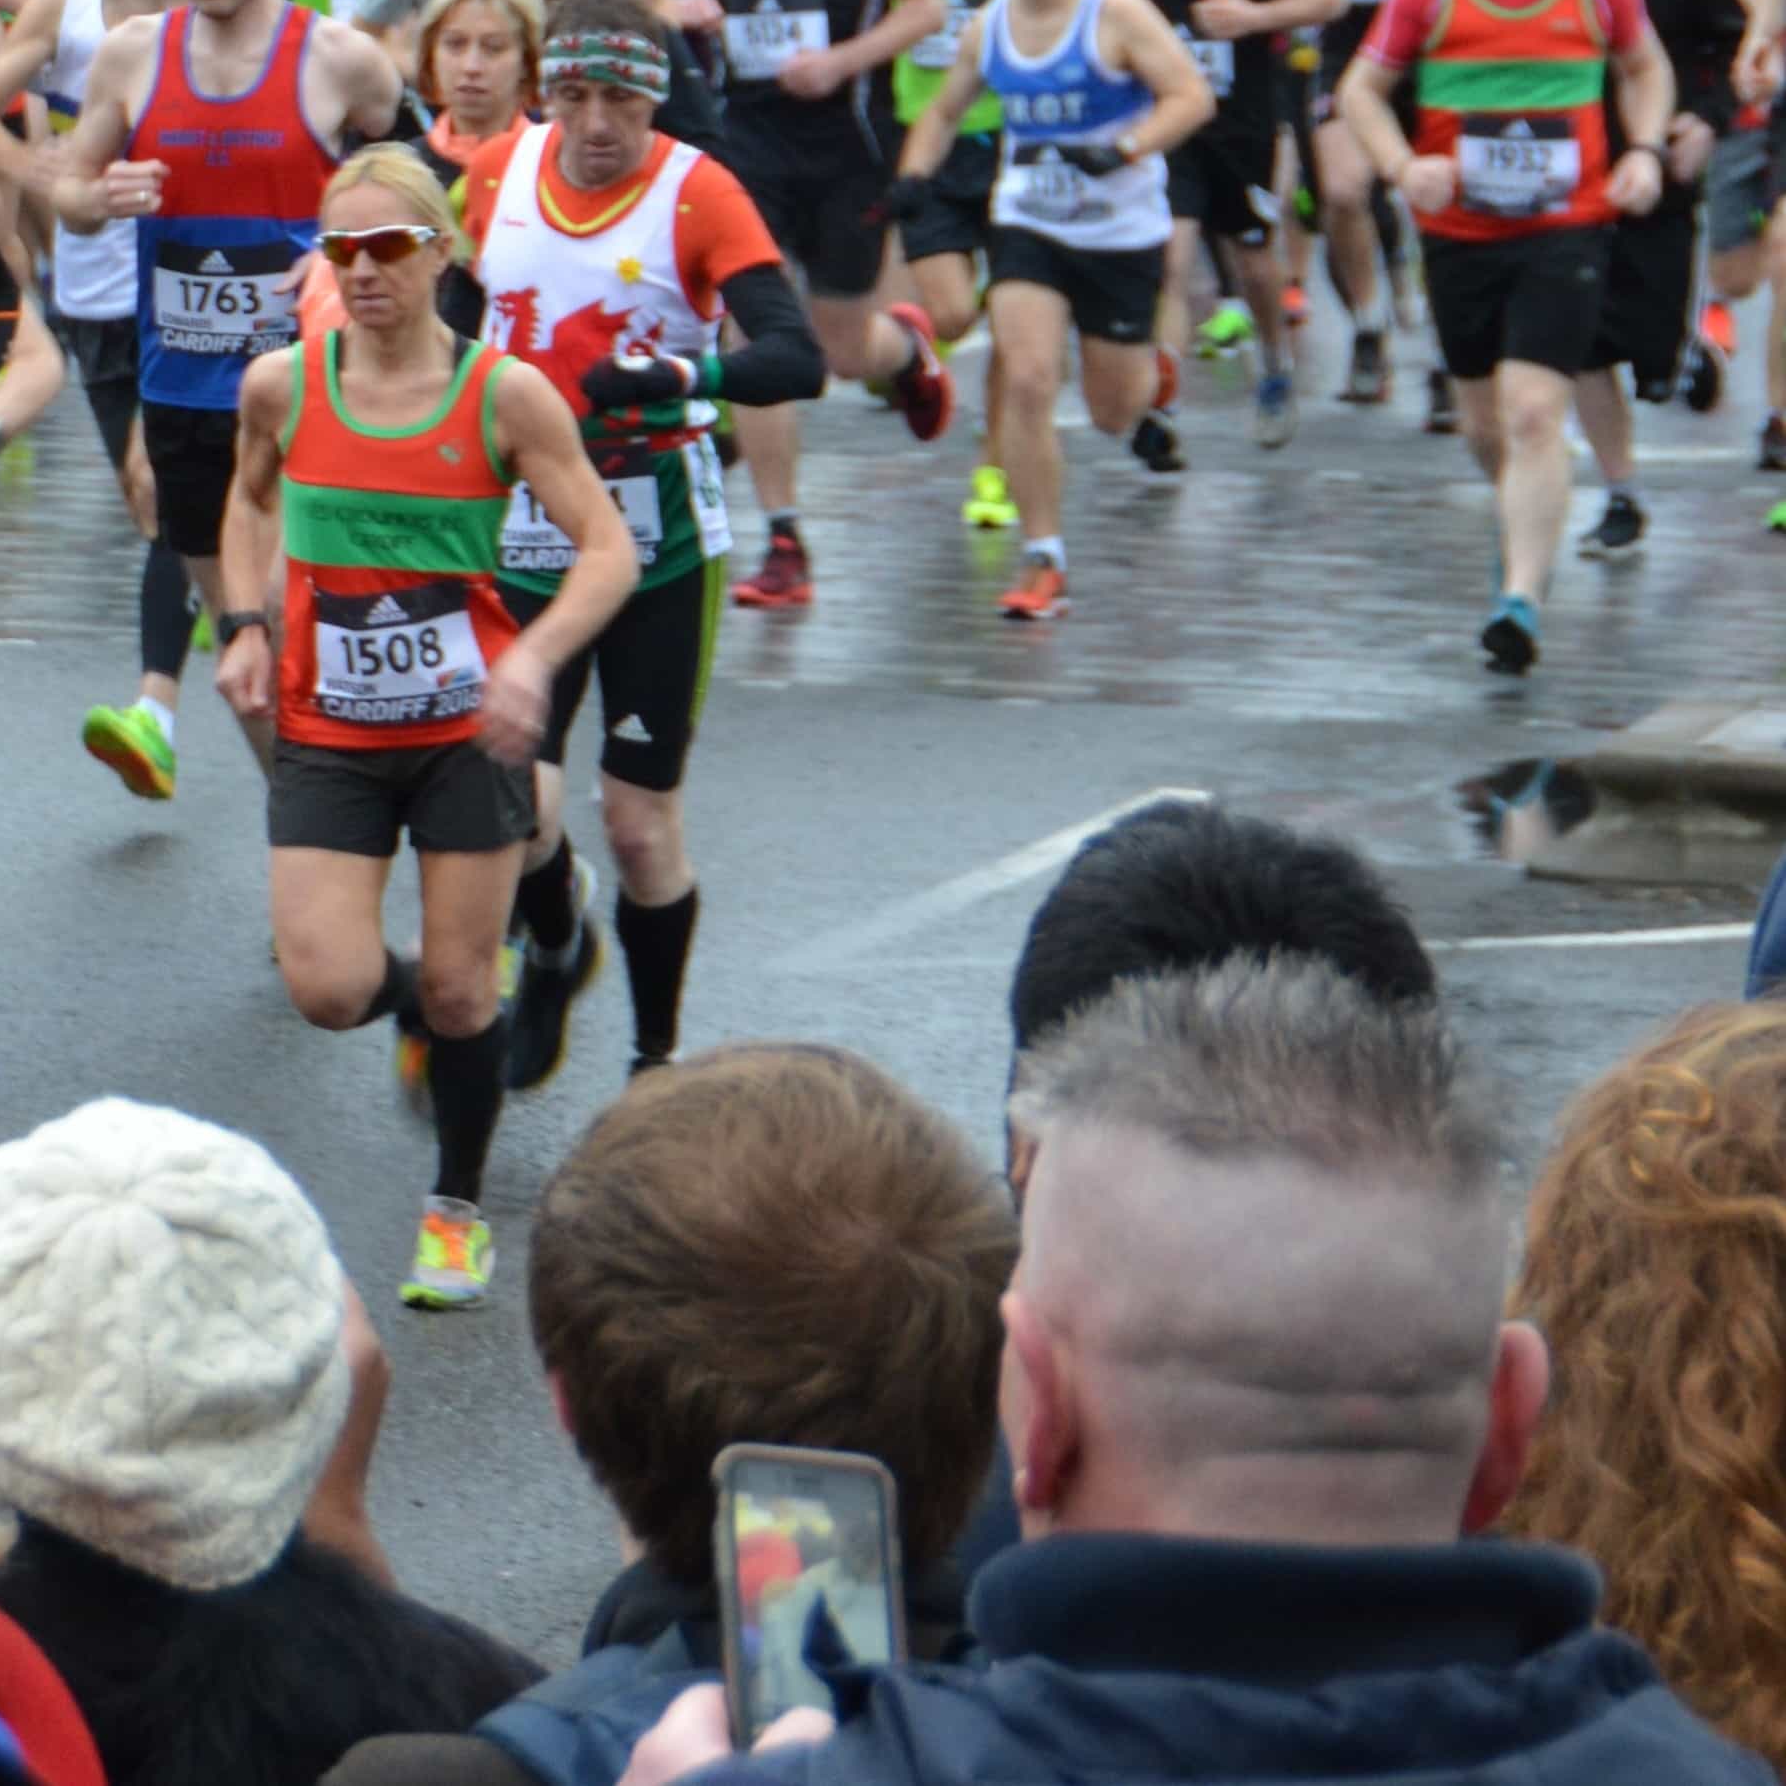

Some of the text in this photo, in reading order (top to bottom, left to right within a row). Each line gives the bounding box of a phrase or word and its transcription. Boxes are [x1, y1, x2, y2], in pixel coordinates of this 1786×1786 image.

[178, 279, 262, 314] 1763
[162, 329, 290, 355] CARDIFF 2016
[340, 627, 444, 677] 1508
[324, 683, 483, 722] CARDIFF 2016
